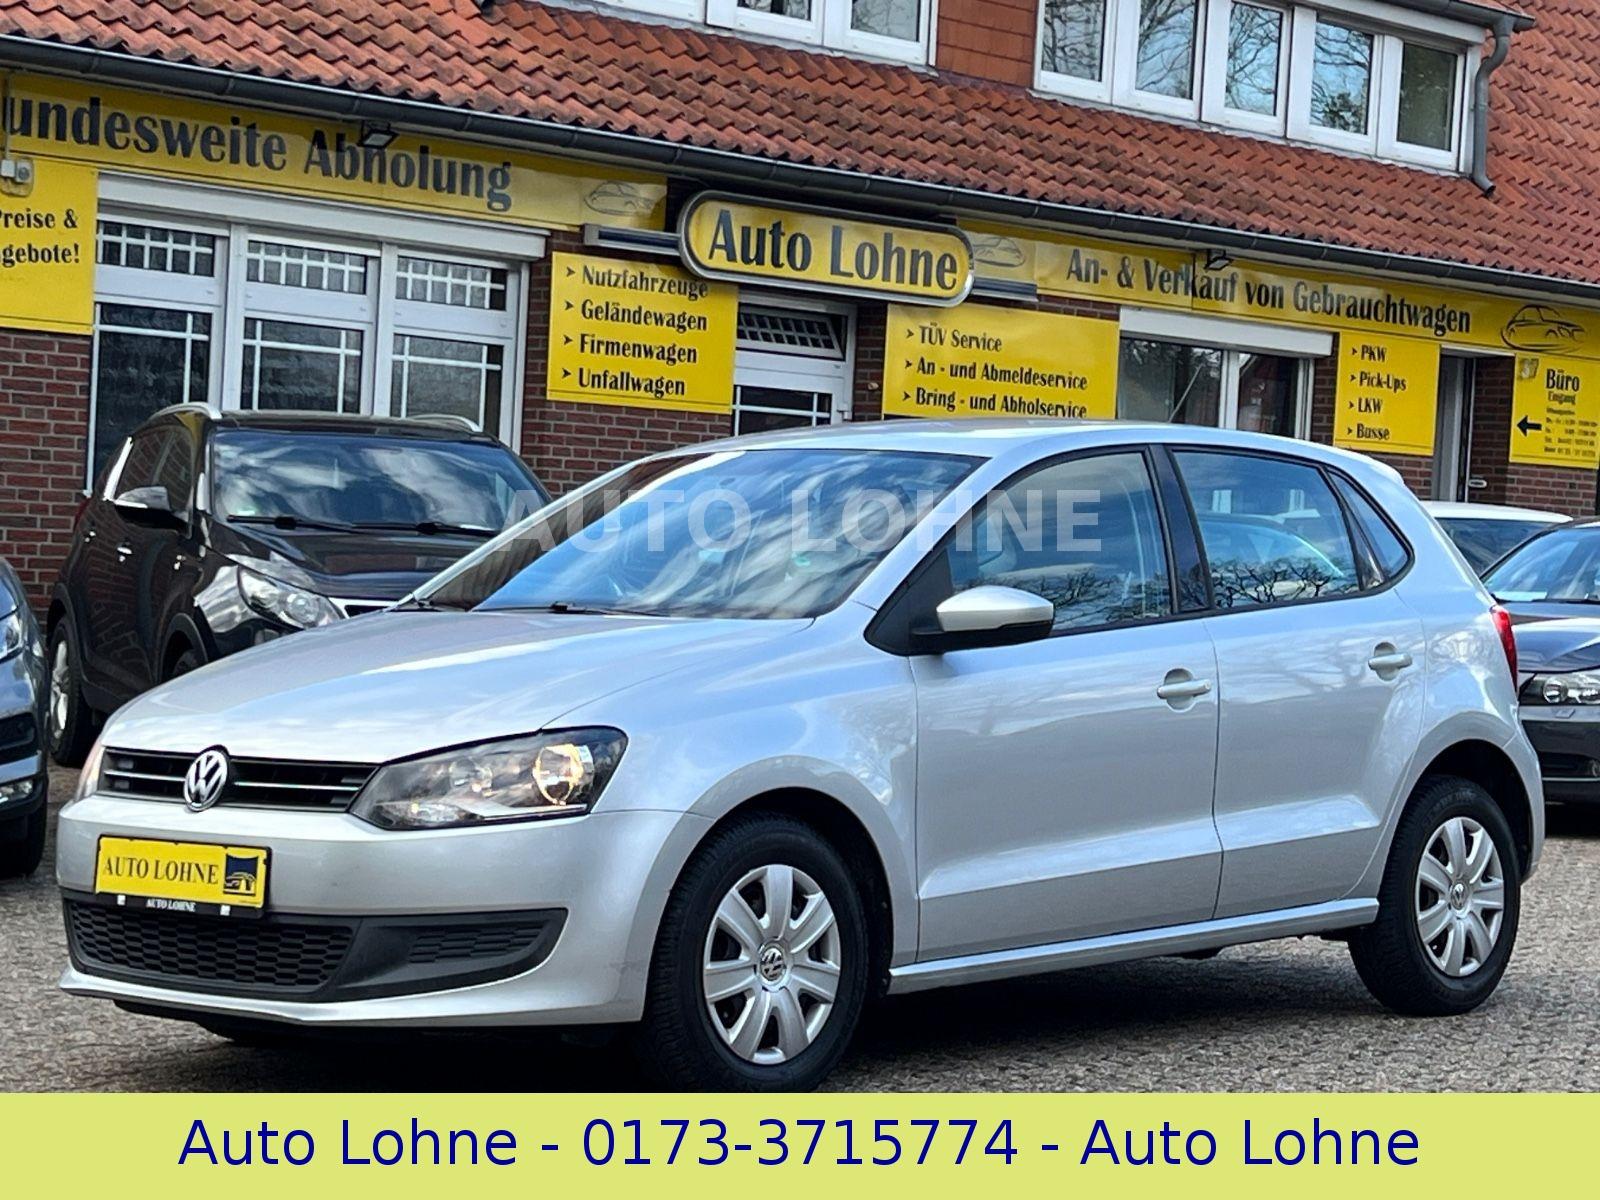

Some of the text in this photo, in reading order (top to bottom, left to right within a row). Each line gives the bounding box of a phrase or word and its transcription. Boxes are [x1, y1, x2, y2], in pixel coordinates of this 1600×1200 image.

[303, 129, 513, 213] Abholung
[63, 208, 78, 229] &
[708, 209, 959, 291] Auto Lohne
[582, 265, 709, 298] Nutzfahrzeuge
[1067, 248, 1471, 337] An- & Verkauf von Gebrauchtwagen
[581, 298, 708, 332] Geländewagen
[579, 333, 698, 366] Firmenwagen
[919, 322, 1003, 352] TÜV Service
[1360, 344, 1387, 363] PKW
[578, 367, 685, 399] Unfallwagen
[916, 356, 936, 375] An
[950, 362, 976, 380] und
[981, 366, 1088, 390] Abmeldeservice
[1359, 370, 1407, 394] Pick-Ups
[1546, 367, 1580, 392] Büro
[916, 387, 956, 413] Bring
[969, 393, 996, 412] und
[1000, 397, 1087, 419] Abholservice
[1357, 397, 1382, 414] LKW
[1356, 423, 1390, 441] Busse
[103, 857, 220, 885] AUTO LOHNE
[145, 898, 197, 912] AUTO LOHNE
